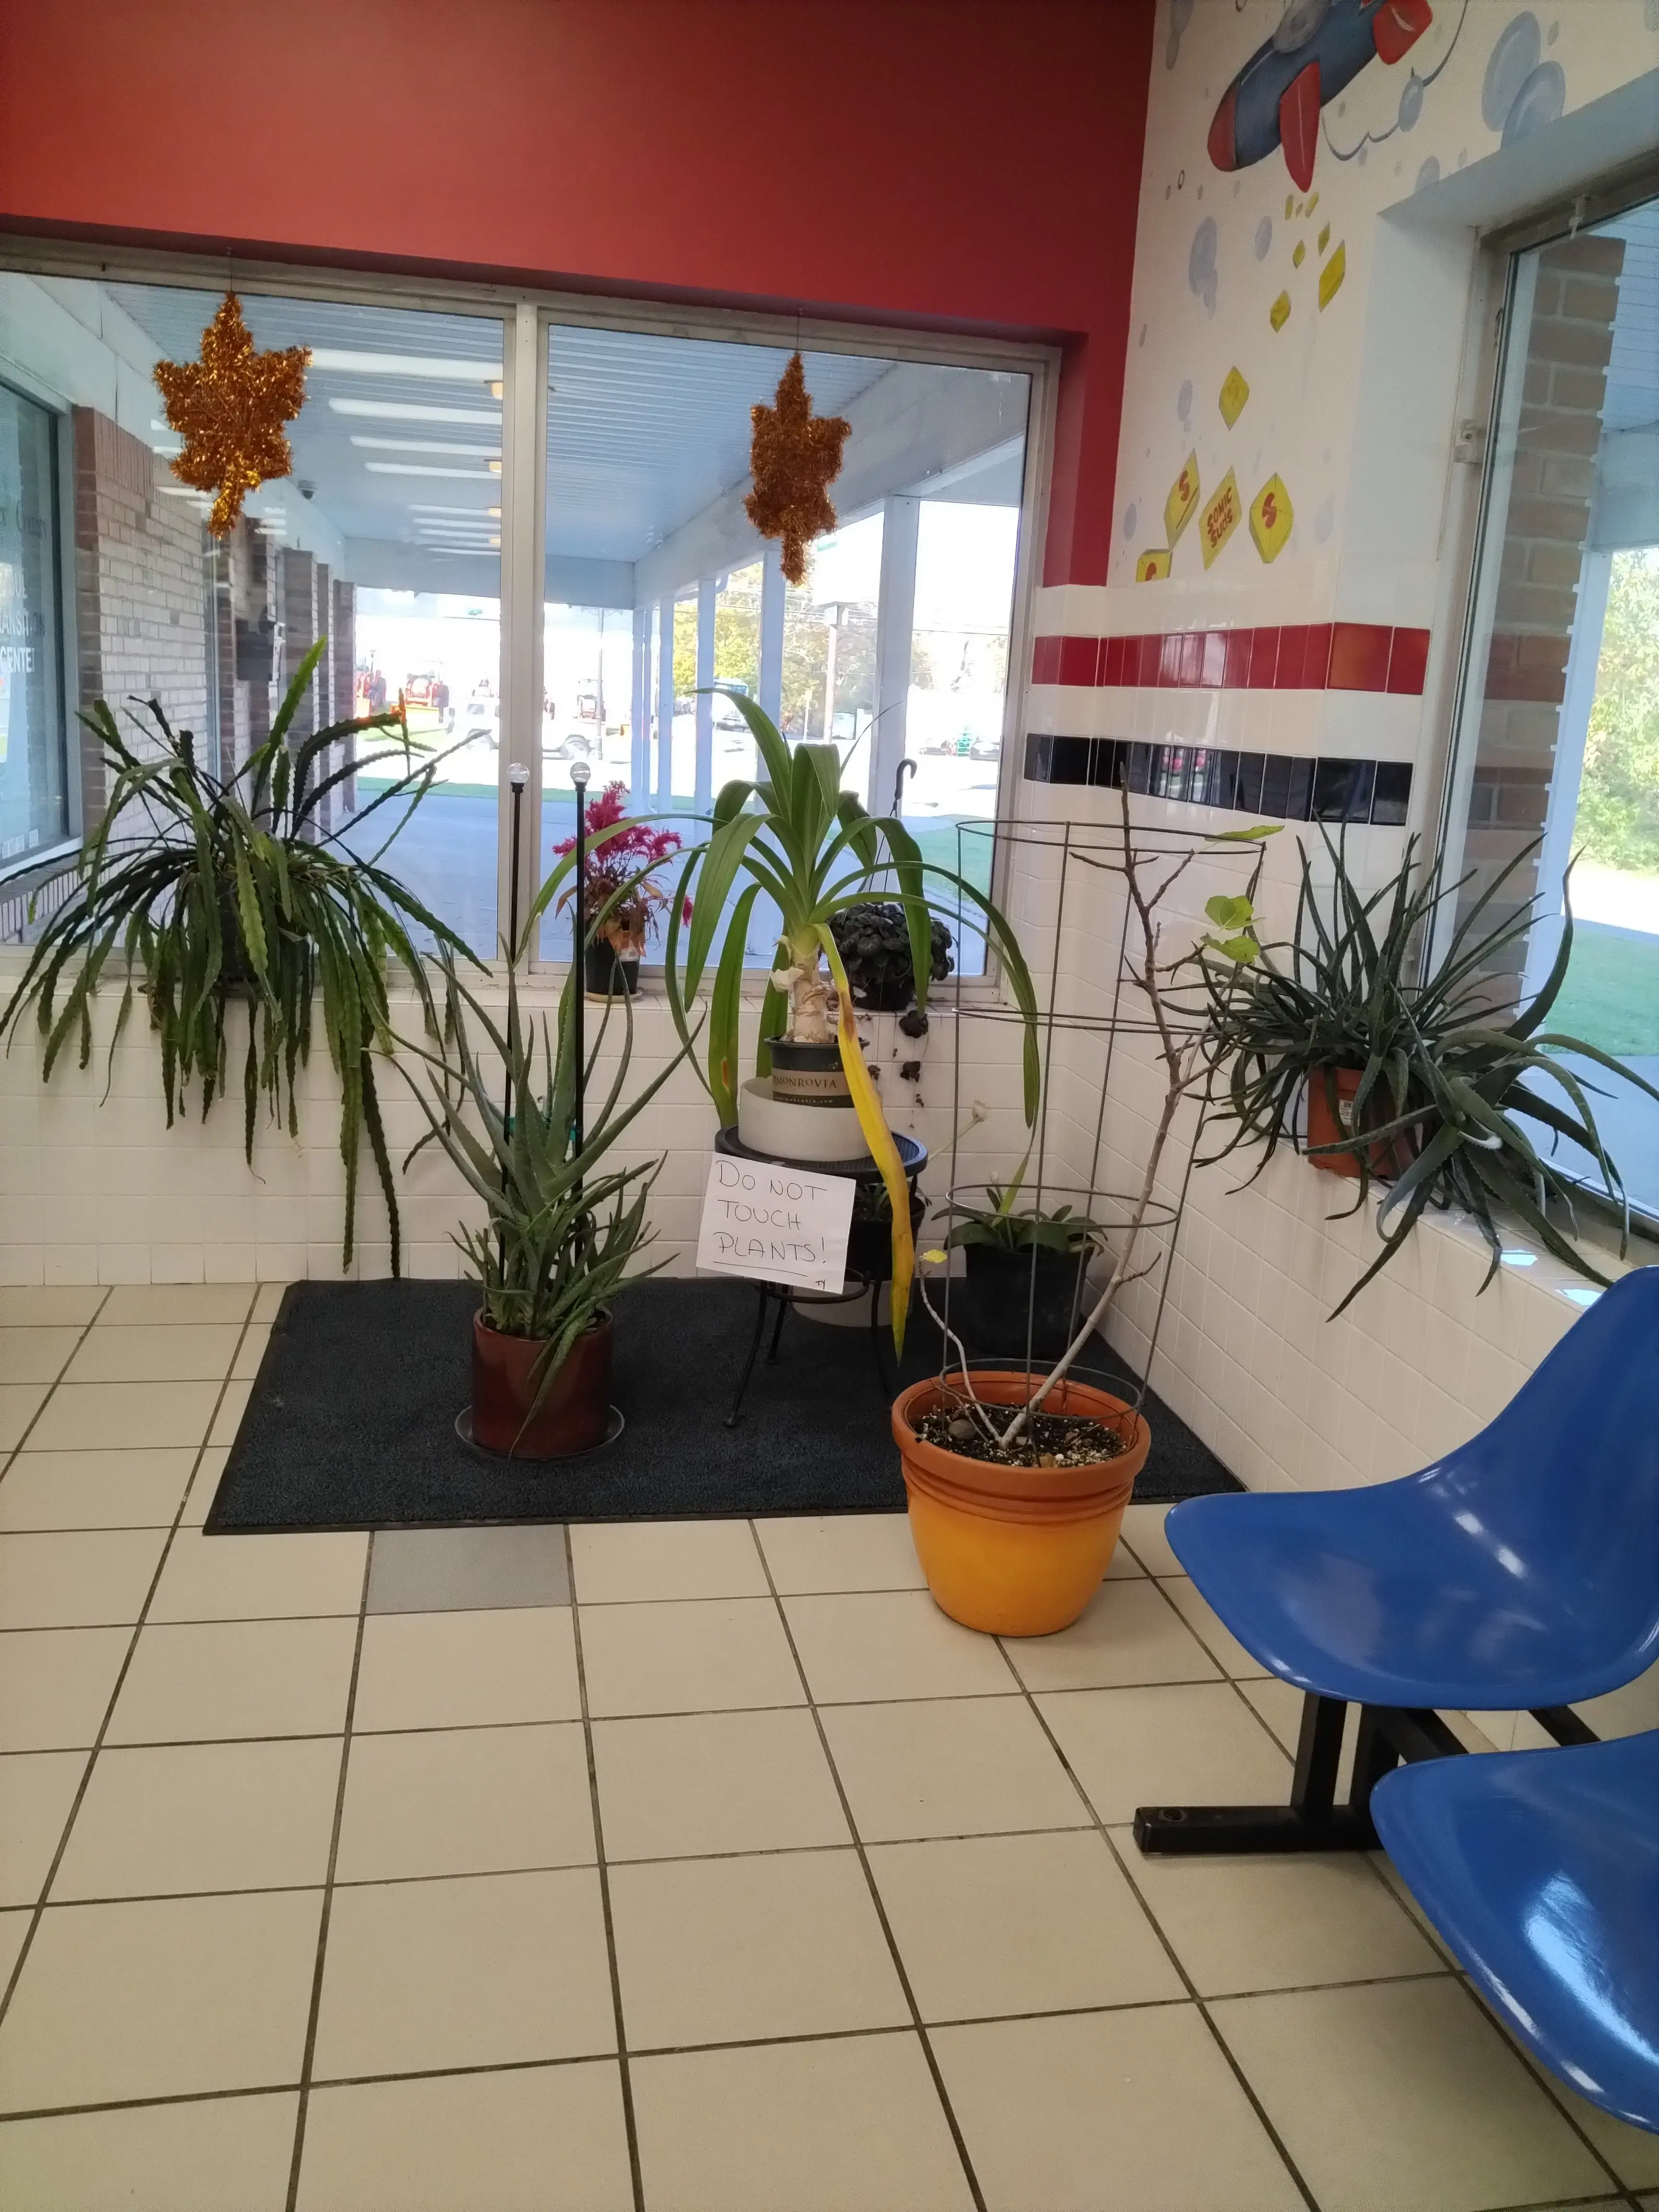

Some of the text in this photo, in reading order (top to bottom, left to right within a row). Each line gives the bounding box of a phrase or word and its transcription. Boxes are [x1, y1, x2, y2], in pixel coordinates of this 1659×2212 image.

[1207, 486, 1232, 535] SONIC
[1211, 508, 1232, 548] SUDS
[776, 1076, 837, 1088] MONROVIA
[715, 1160, 828, 1201] DO NOT
[717, 1199, 801, 1230] TOUCH
[712, 1231, 827, 1263] PLANTS!
